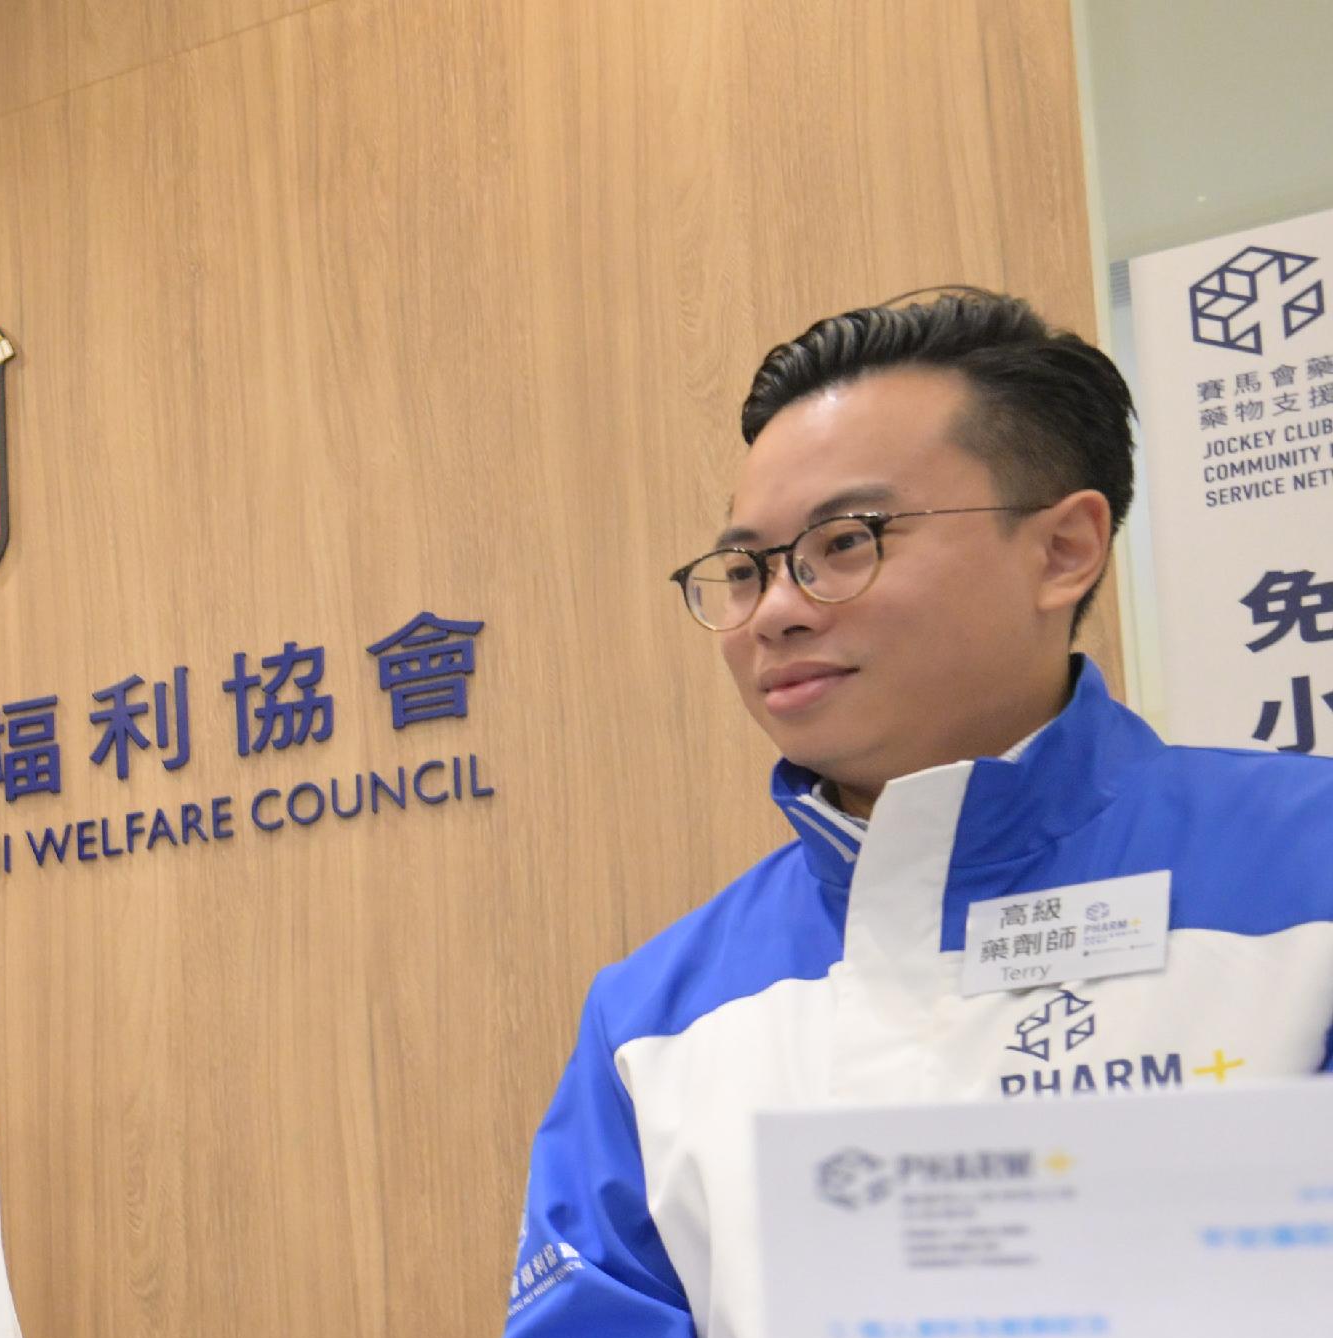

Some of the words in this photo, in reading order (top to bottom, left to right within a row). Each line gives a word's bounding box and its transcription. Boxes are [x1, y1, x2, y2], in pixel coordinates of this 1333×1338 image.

[1203, 428, 1276, 460] JOCKEY
[1284, 417, 1333, 442] CLUB
[1203, 444, 1322, 484] COMMUNITY
[1205, 477, 1286, 508] SERVICE
[1293, 468, 1333, 491] NET
[1238, 569, 1333, 653] 免
[26, 796, 233, 867] WELFARE
[251, 754, 494, 832] COUNCIL
[1000, 897, 1061, 929] 高級
[980, 925, 1077, 963] 藥劑師
[1001, 963, 1051, 982] Terry
